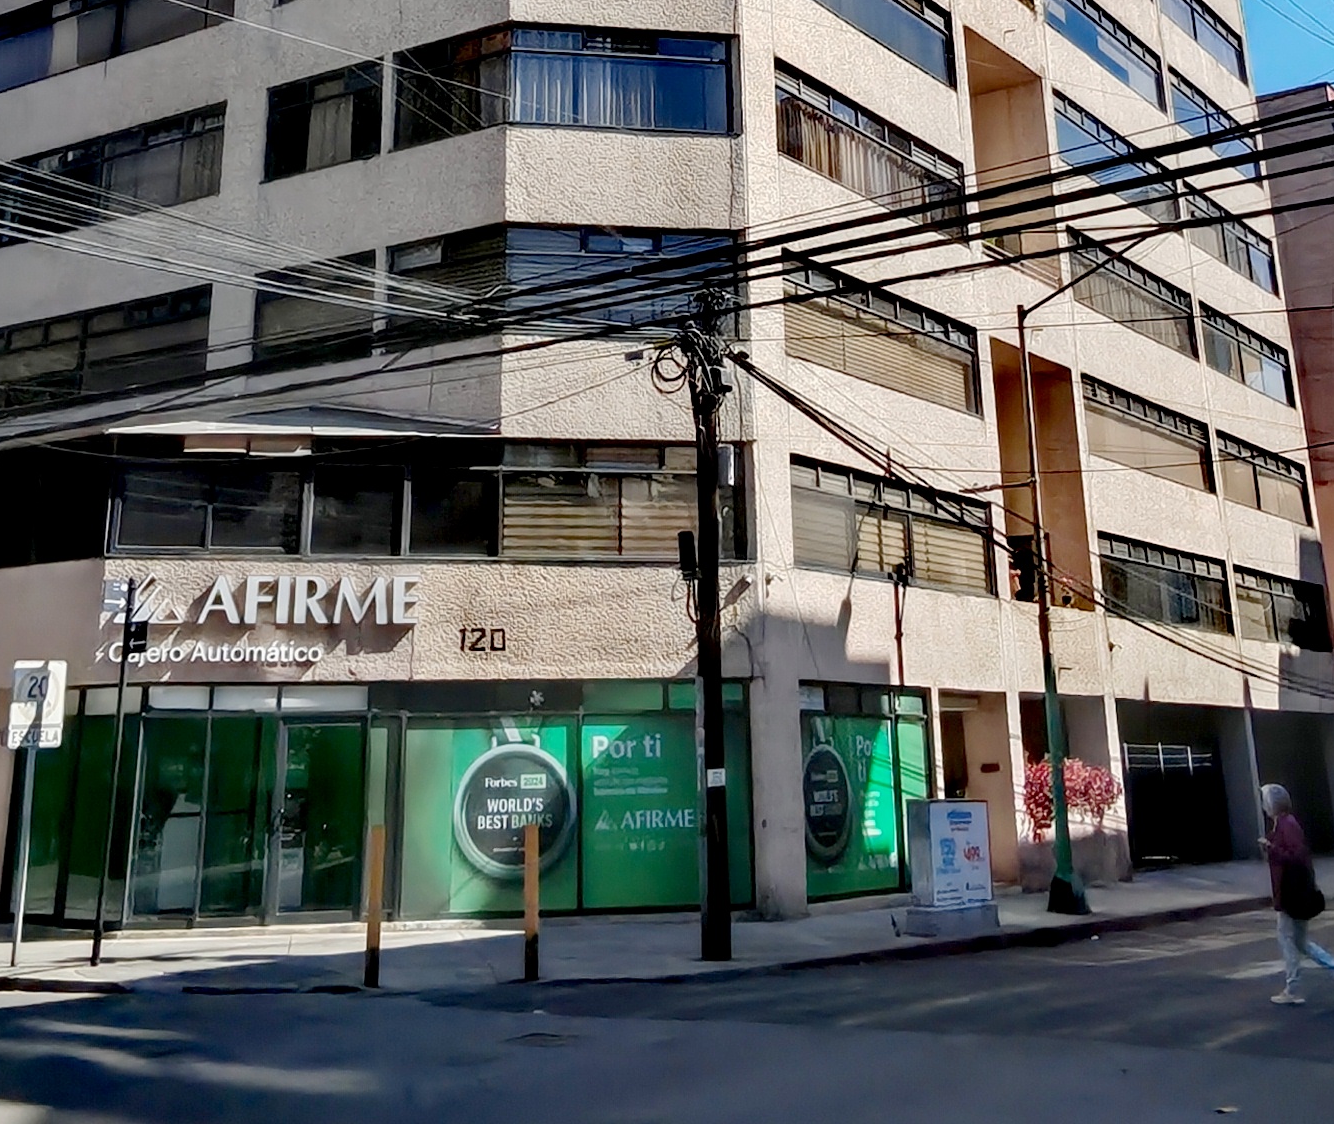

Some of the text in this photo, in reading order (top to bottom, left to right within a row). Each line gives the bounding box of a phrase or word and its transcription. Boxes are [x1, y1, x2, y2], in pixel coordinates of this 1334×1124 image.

[197, 575, 418, 625] AFIRME
[459, 626, 506, 651] 120
[108, 640, 323, 667] Cajero Automático
[27, 675, 49, 699] 20
[11, 730, 59, 745] ESCUELA
[591, 733, 662, 759] Por ti
[484, 776, 518, 788] Forbes
[486, 797, 544, 813] WORLD'S
[477, 812, 553, 831] BEST BANKS
[620, 808, 695, 830] AFIRME
